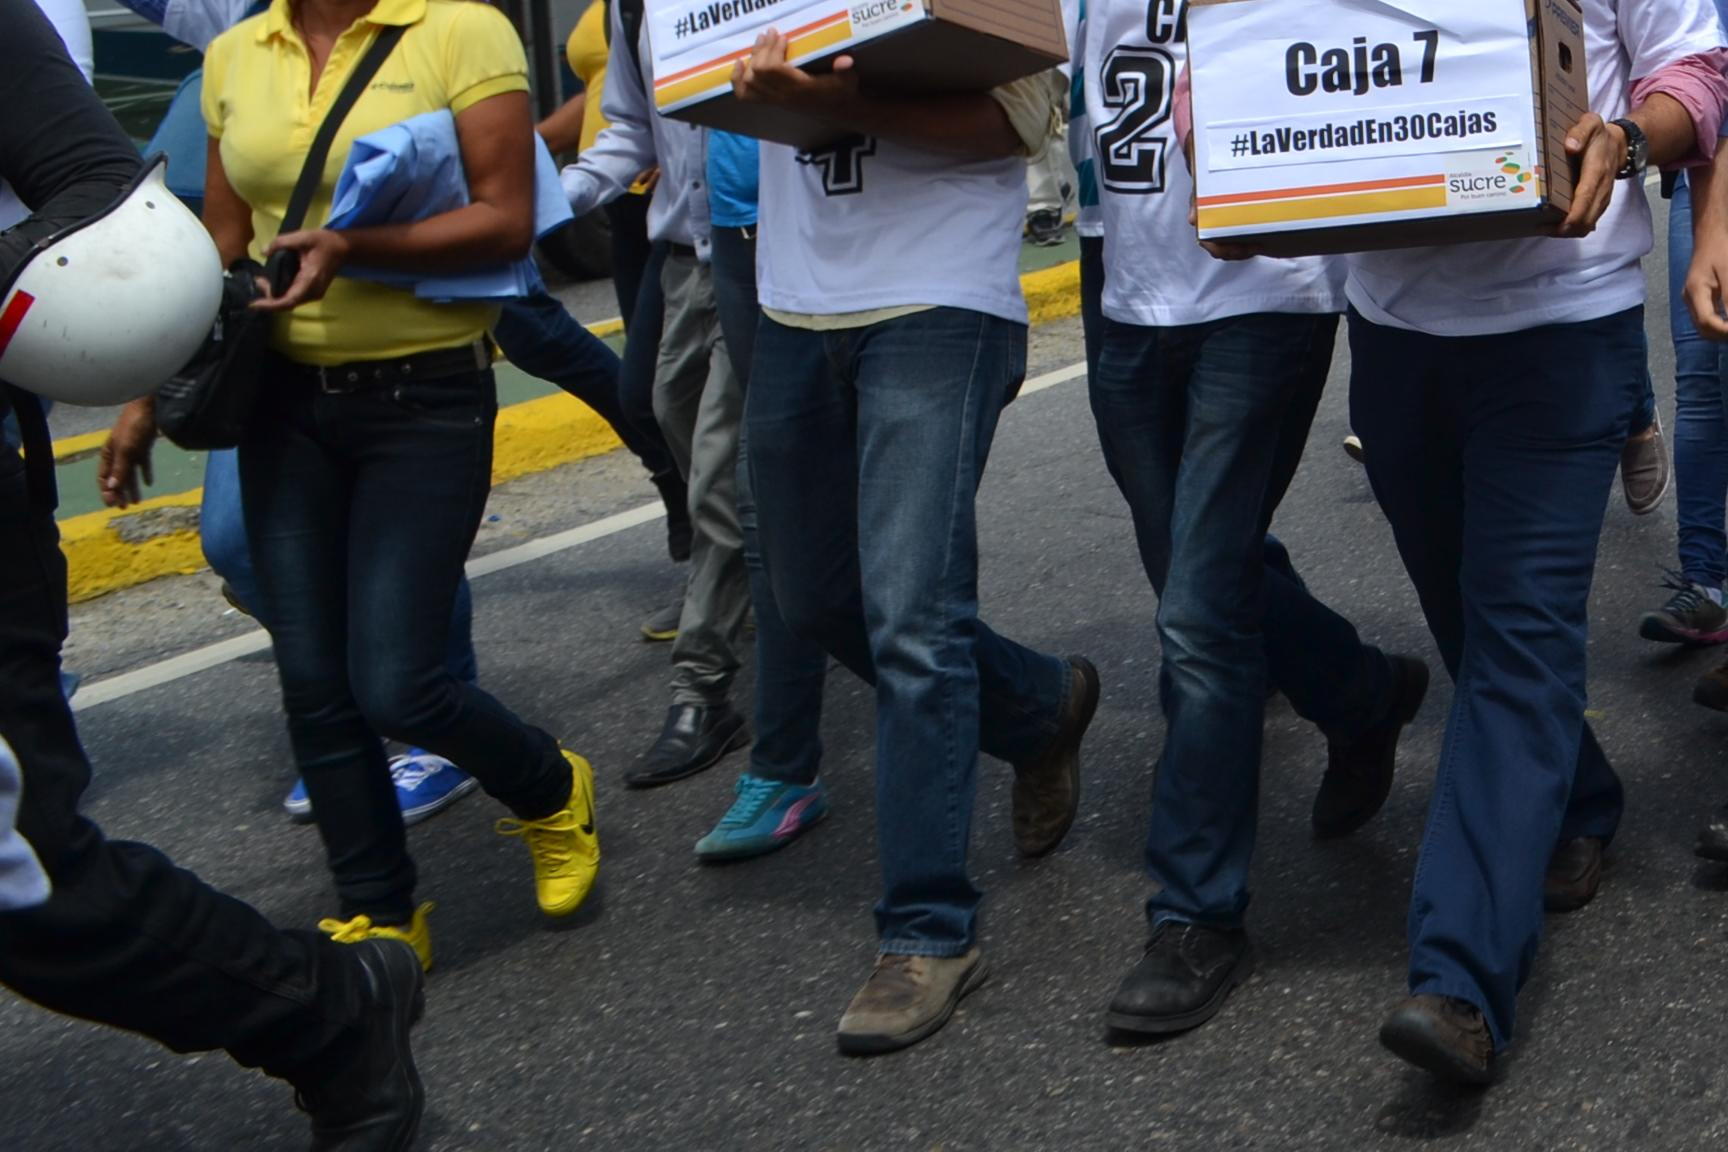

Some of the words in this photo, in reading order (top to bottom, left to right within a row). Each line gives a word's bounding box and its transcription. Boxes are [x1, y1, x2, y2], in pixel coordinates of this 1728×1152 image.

[1284, 35, 1403, 98] Caja
[1412, 29, 1440, 84] 7
[1094, 44, 1176, 194] 2
[1230, 109, 1498, 158] #LaVerdadEn30Cajas
[1449, 174, 1507, 194] sucre
